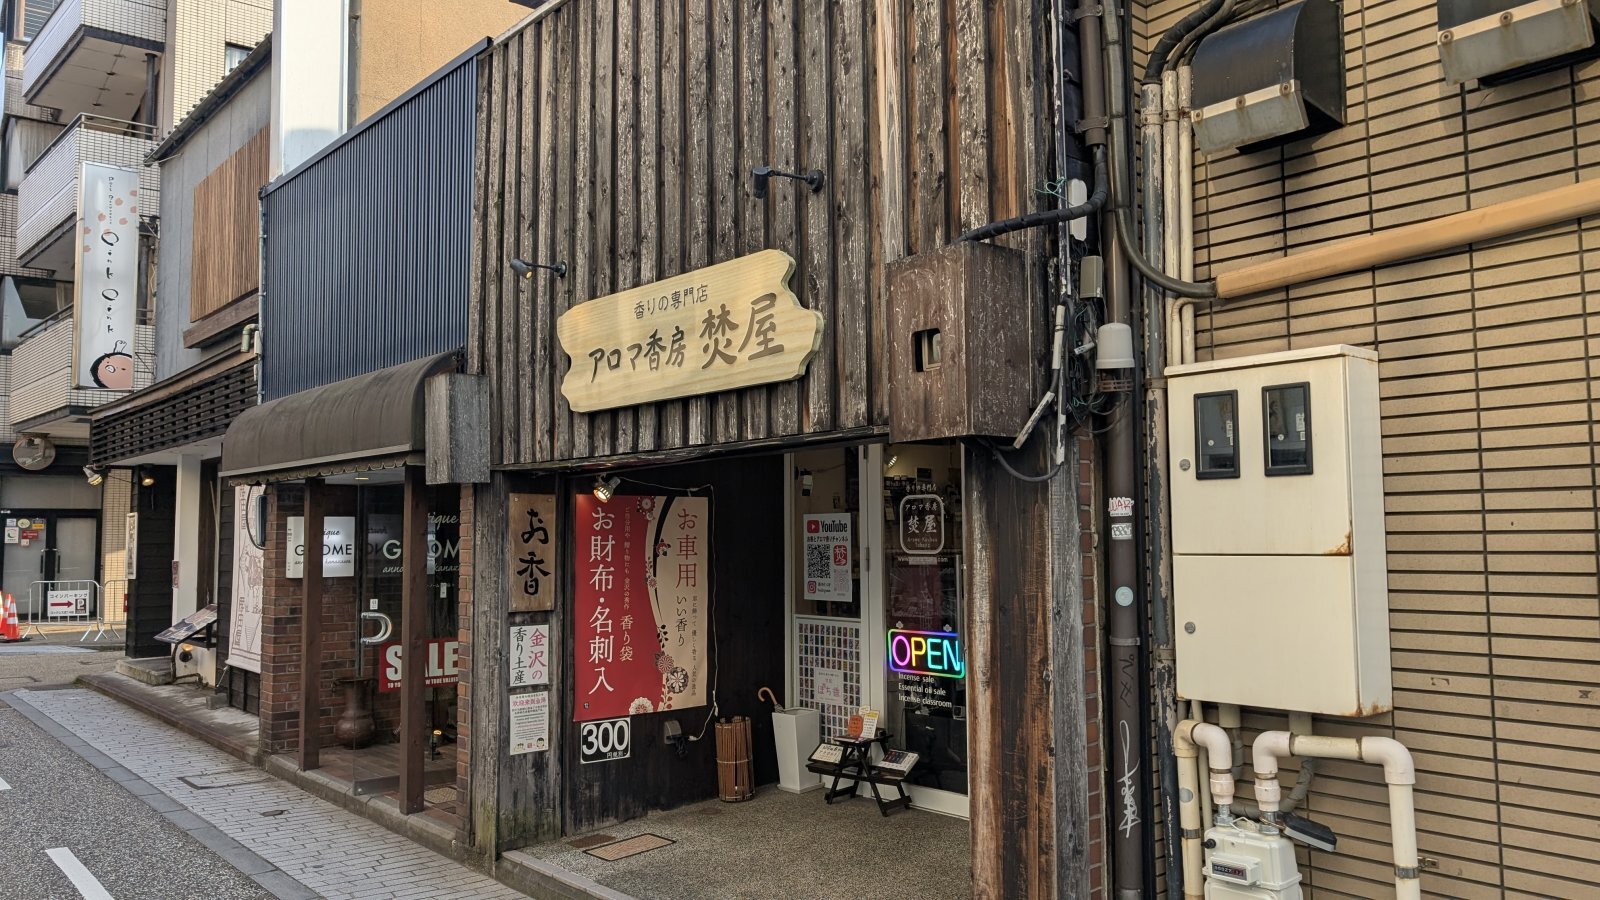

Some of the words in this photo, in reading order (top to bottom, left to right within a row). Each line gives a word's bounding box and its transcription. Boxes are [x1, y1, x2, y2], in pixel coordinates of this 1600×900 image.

[102, 288, 119, 333] Oink
[633, 284, 708, 319] 香りの専門店
[588, 325, 687, 383] アロマ香房
[699, 292, 785, 370] 焚屋
[905, 503, 937, 511] アロマ香房
[907, 515, 937, 533] 焚屋
[324, 528, 340, 539] ique
[820, 519, 848, 533] YouTube
[294, 544, 353, 556] GOME
[383, 539, 460, 560] GOM
[516, 508, 551, 595] お香
[675, 508, 698, 588] お車用
[588, 506, 615, 695] お財布・名刺入
[619, 615, 634, 661] 香り袋
[675, 595, 687, 646] いい香り
[386, 641, 459, 680] SLE
[512, 627, 527, 685] 香り土産
[528, 628, 547, 680] 金沢の
[892, 635, 961, 671] OPEN
[898, 683, 923, 693] Essential
[933, 688, 946, 696] sale
[899, 673, 920, 682] Incense
[922, 675, 935, 683] sale
[898, 694, 921, 704] Incense
[922, 698, 952, 708] classroom
[582, 720, 629, 755] 300
